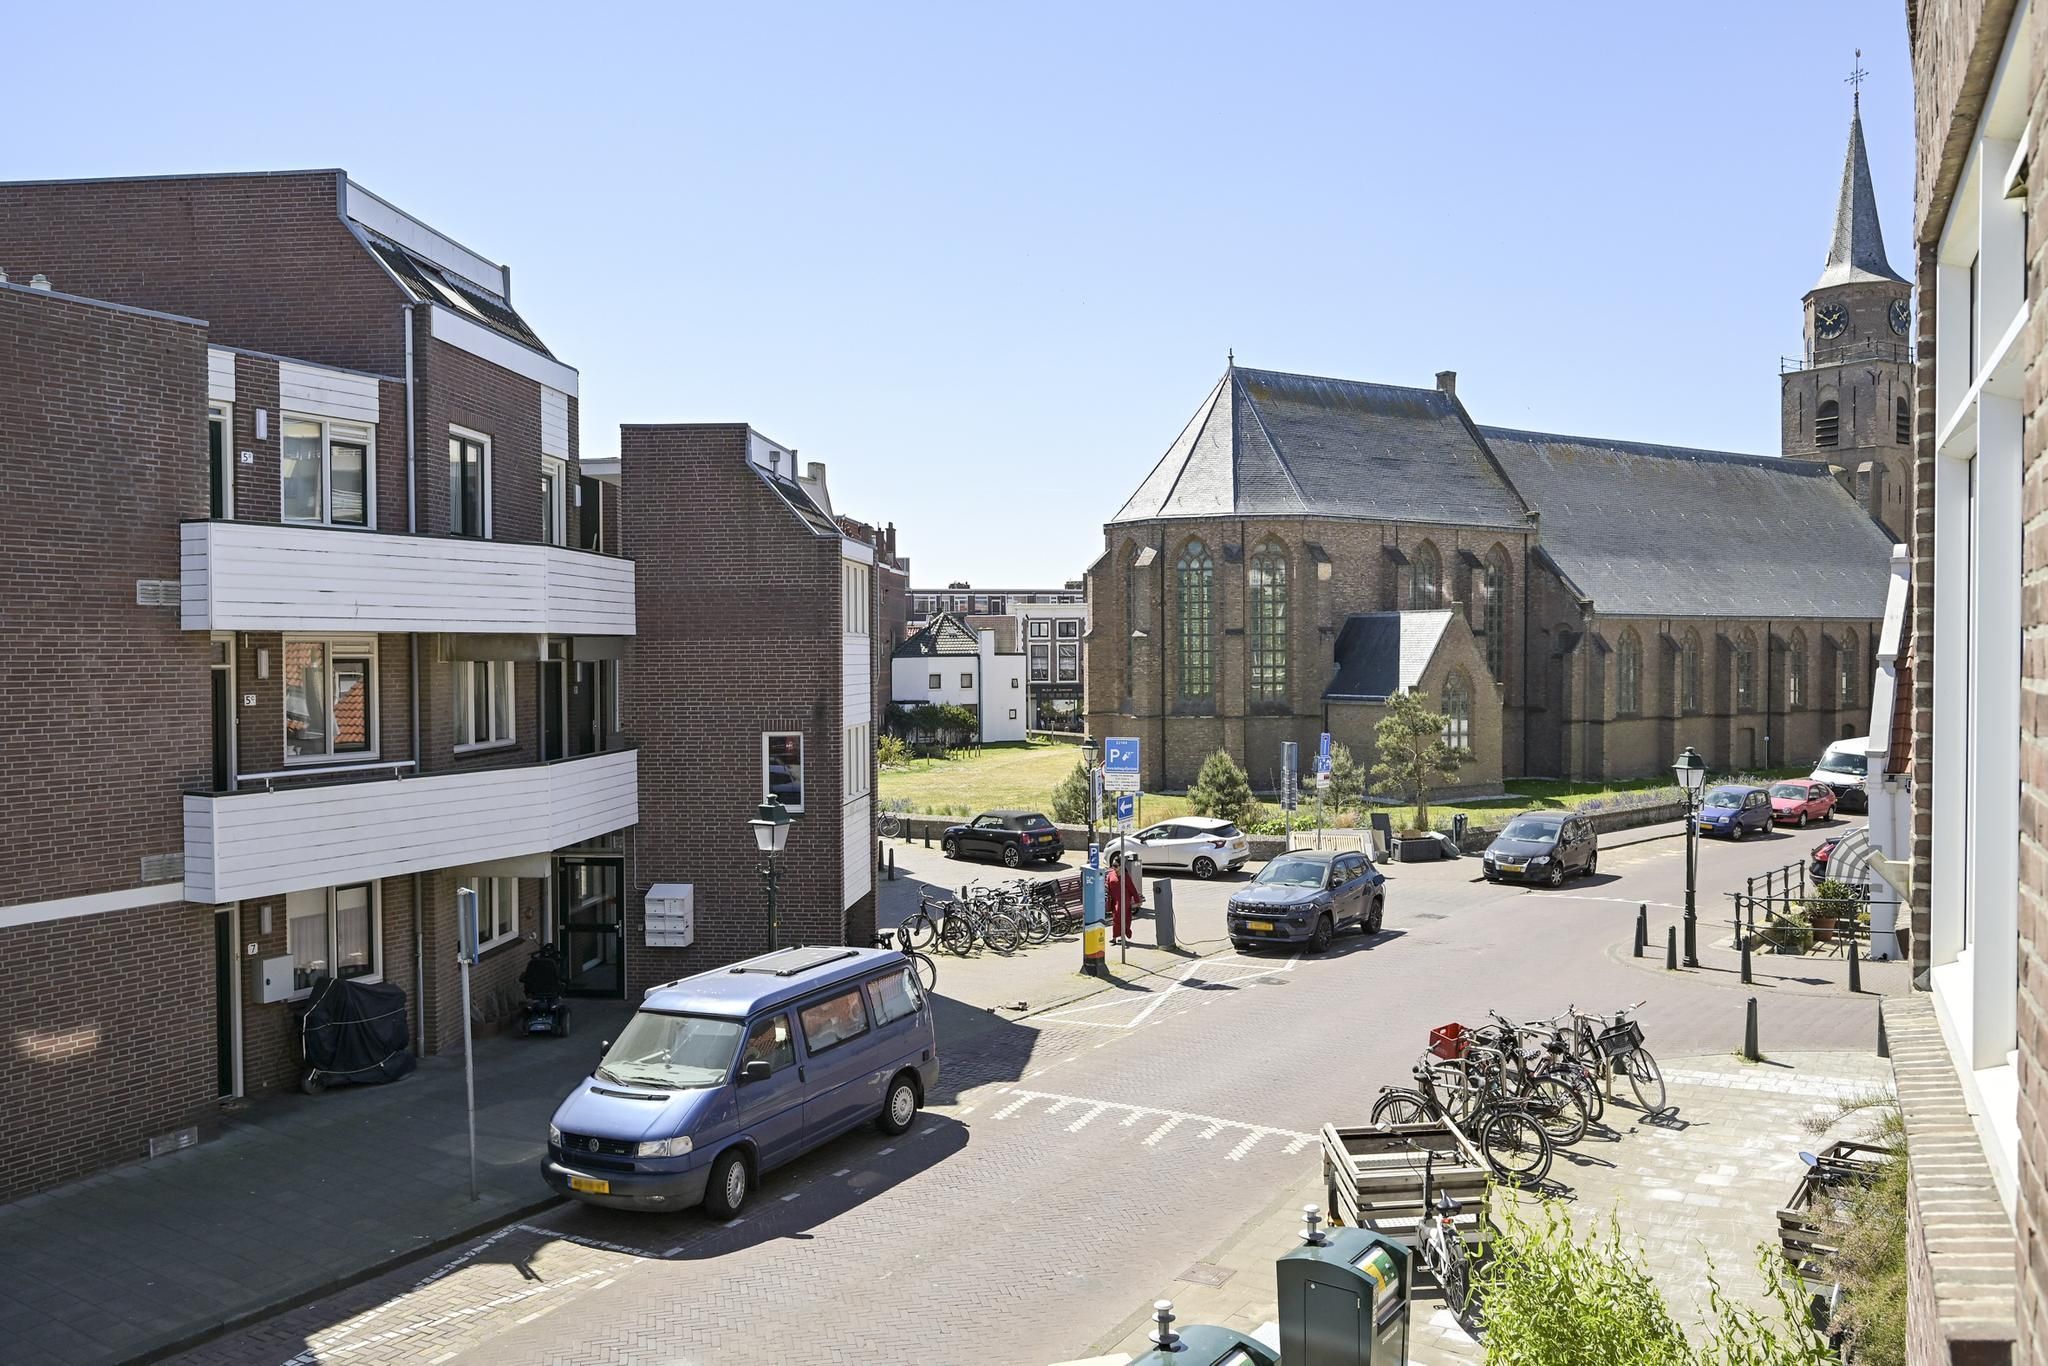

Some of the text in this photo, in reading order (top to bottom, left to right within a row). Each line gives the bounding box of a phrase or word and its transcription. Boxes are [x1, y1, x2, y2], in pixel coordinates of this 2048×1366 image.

[1110, 748, 1120, 763] P
[1090, 847, 1098, 857] P
[250, 944, 256, 953] 7
